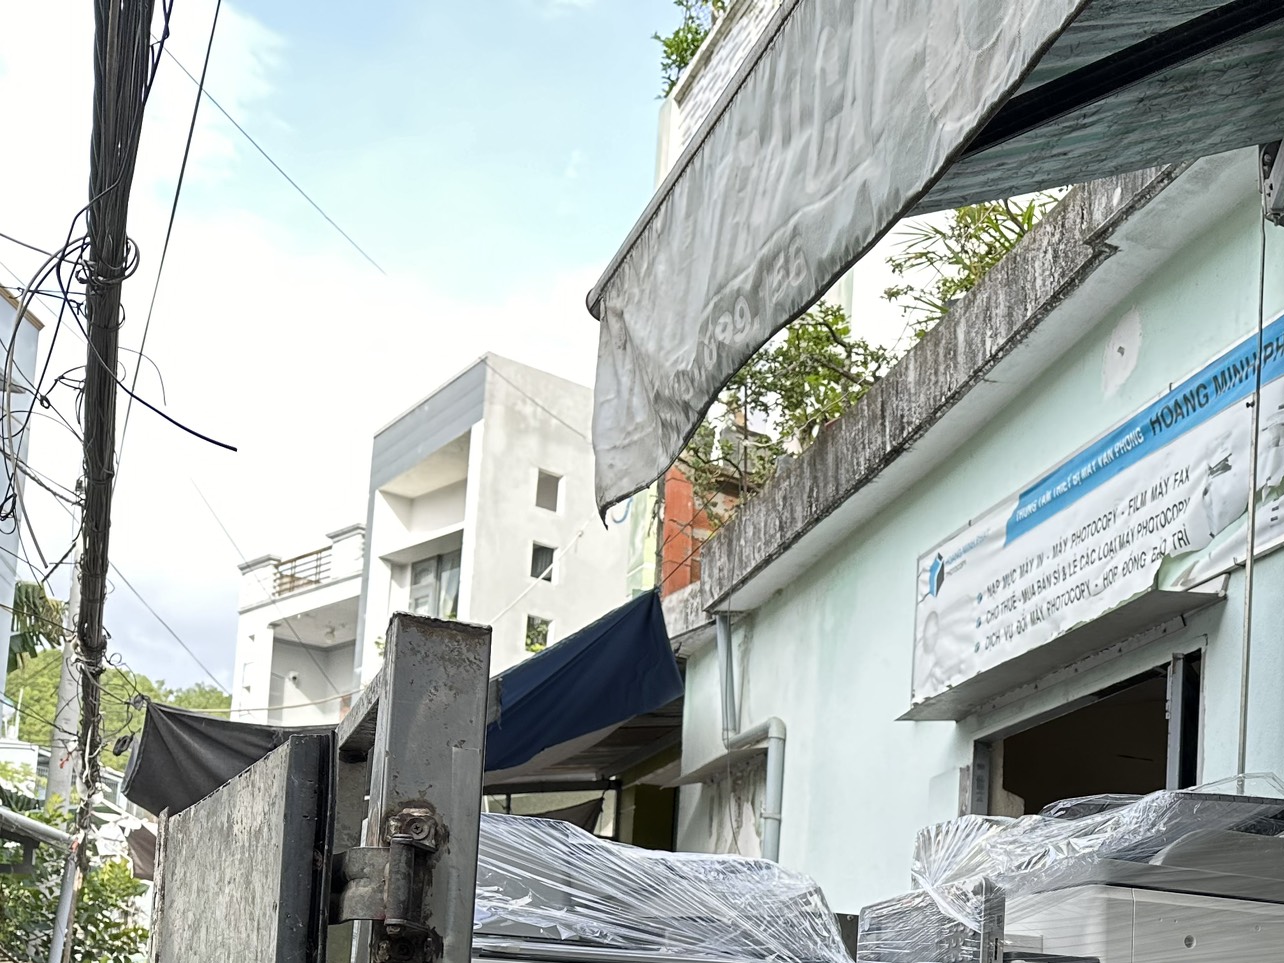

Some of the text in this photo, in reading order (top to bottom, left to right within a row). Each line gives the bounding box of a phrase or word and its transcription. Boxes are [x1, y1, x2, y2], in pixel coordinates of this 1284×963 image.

[1212, 352, 1257, 398] MINH
[1070, 507, 1118, 549] PHOTOCOPY
[1128, 490, 1148, 516] FILM
[1173, 466, 1191, 493] FAX
[1080, 546, 1096, 571] CÁC
[1136, 497, 1190, 538] PHOTOCOPY
[1046, 579, 1092, 617] PHOTOCOPY
